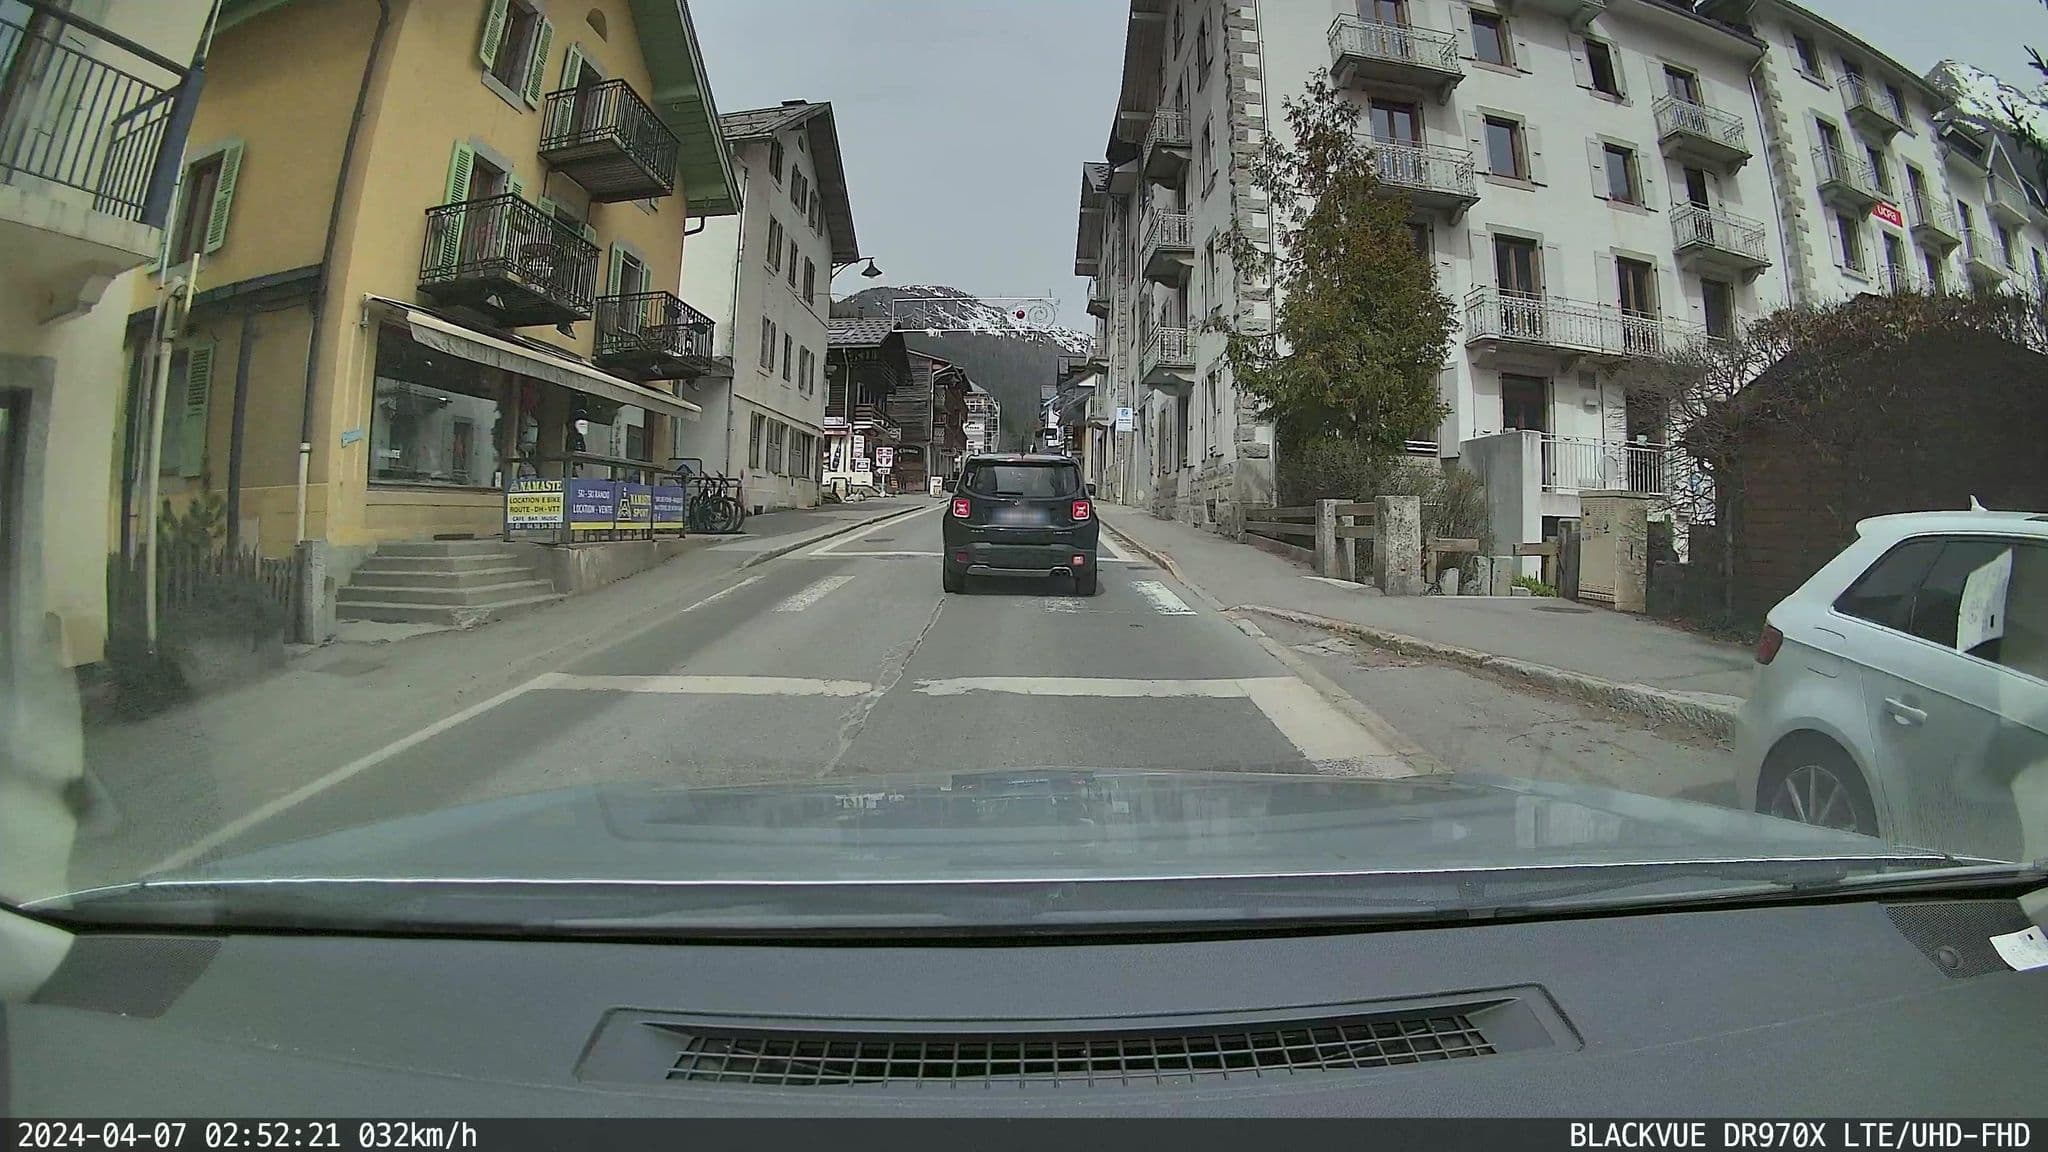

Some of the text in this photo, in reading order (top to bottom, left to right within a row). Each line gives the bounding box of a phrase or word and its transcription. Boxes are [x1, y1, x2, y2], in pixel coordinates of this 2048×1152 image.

[520, 480, 562, 491] NAMASTE
[573, 504, 595, 514] LOCATION
[598, 505, 613, 514] VENTE
[633, 508, 649, 517] SPORT
